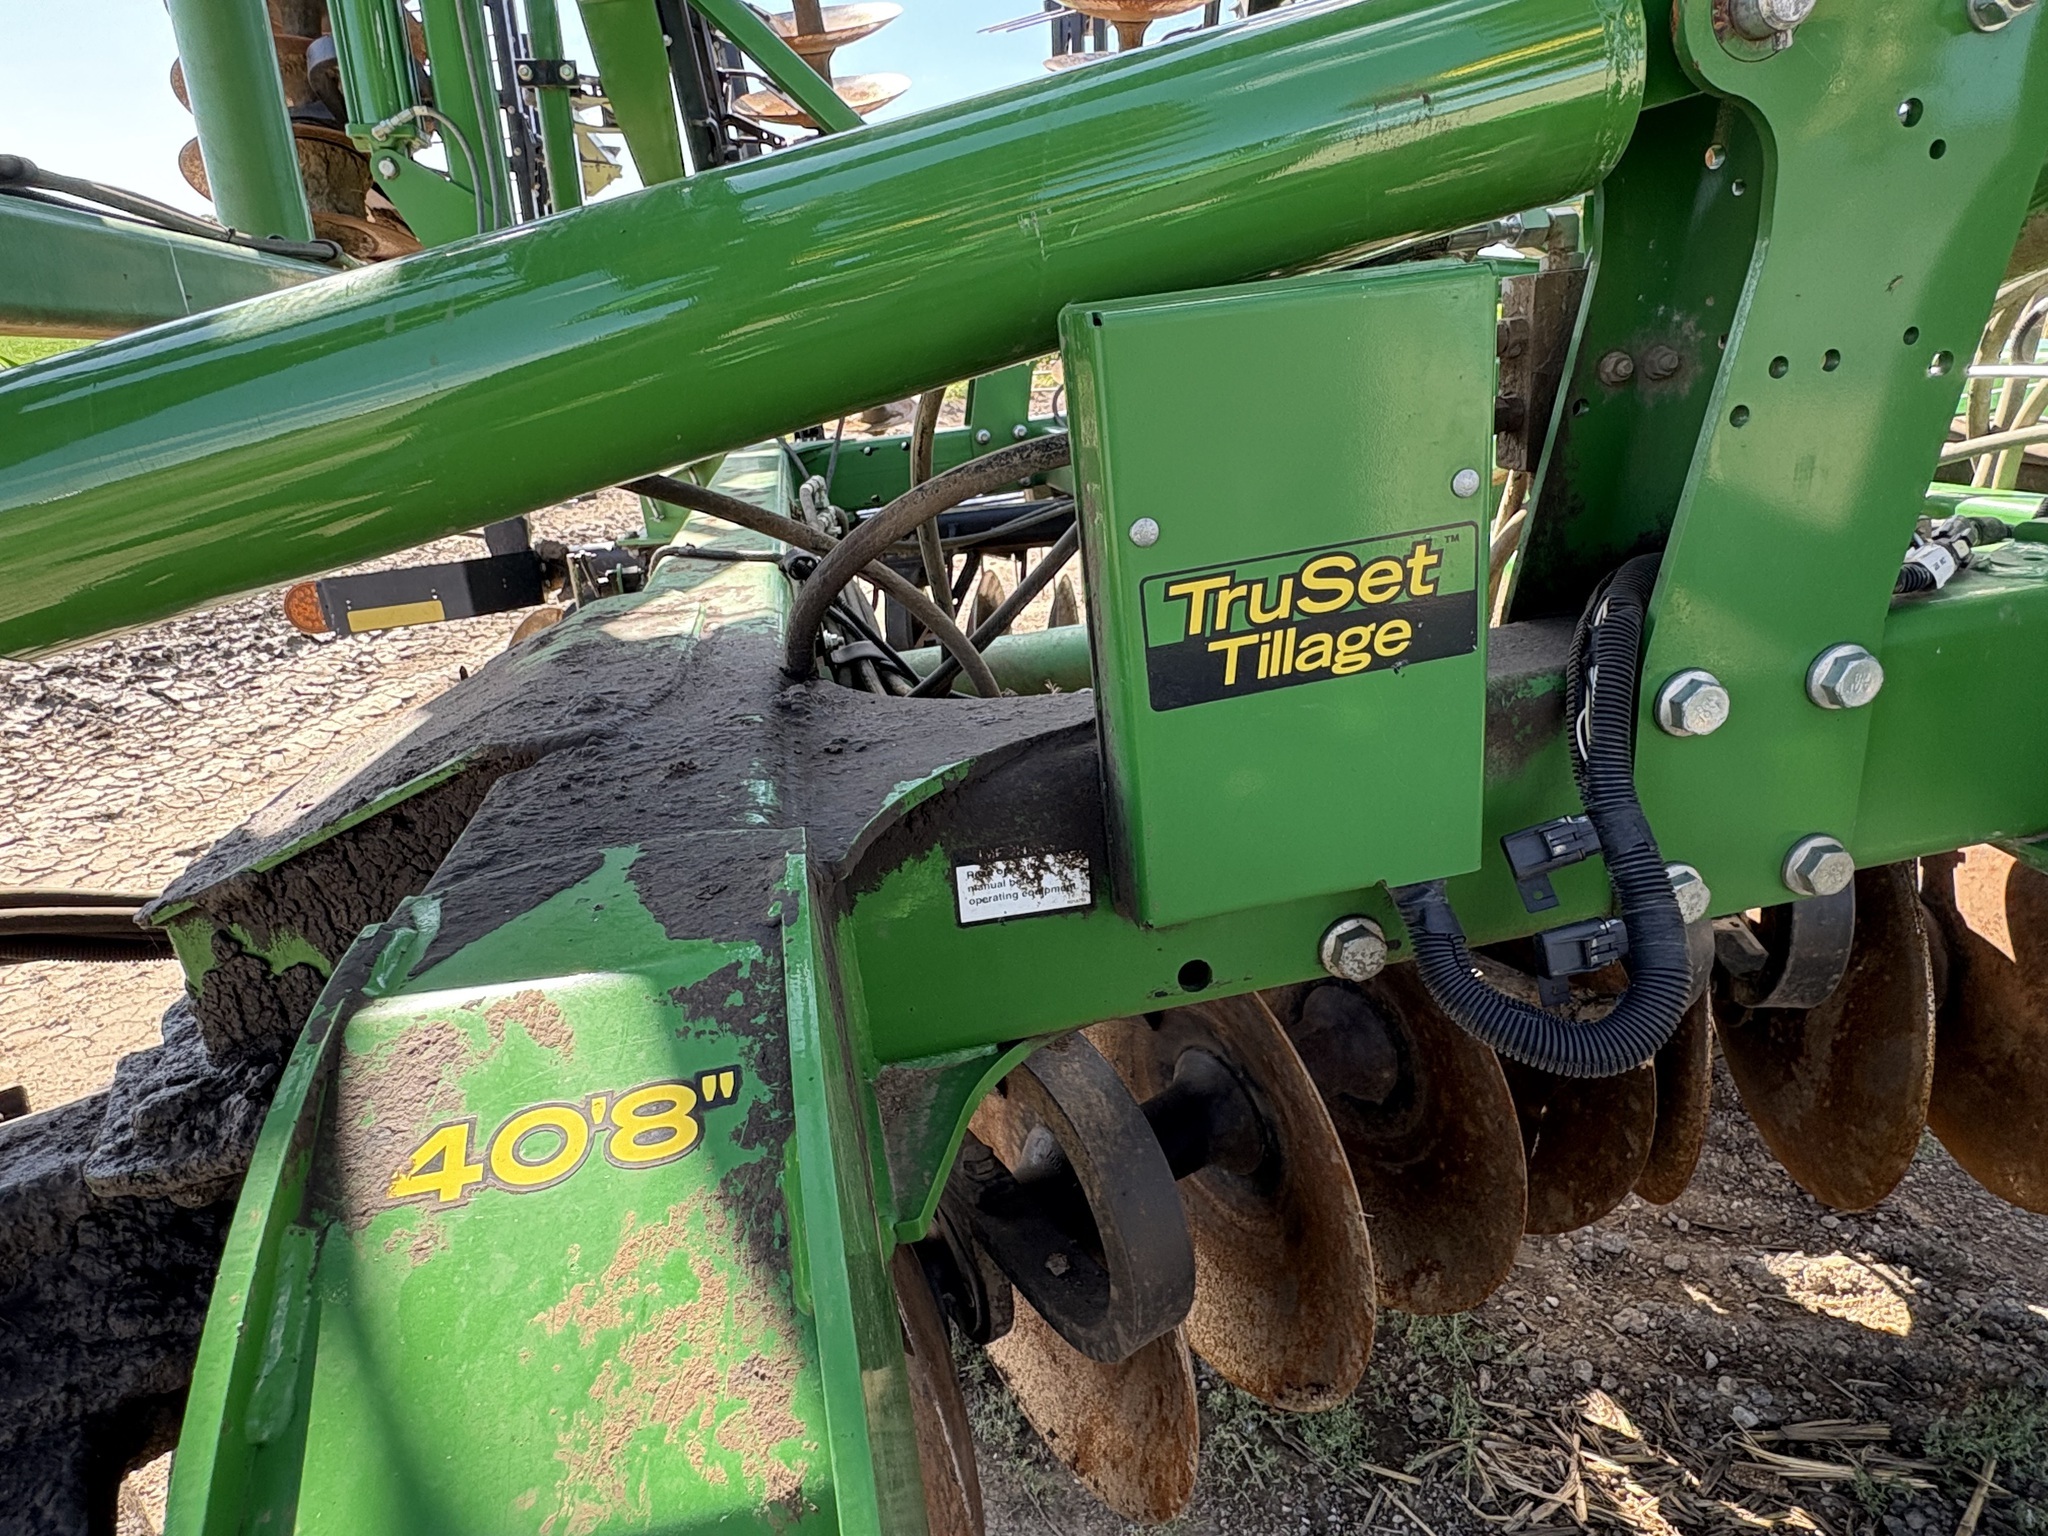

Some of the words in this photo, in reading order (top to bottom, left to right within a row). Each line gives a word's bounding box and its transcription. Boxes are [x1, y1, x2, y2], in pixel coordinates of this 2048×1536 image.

[1168, 543, 1439, 636] TruSet
[1207, 618, 1413, 686] Tillage
[968, 891, 1019, 907] operating
[387, 1070, 735, 1202] 40'8"
